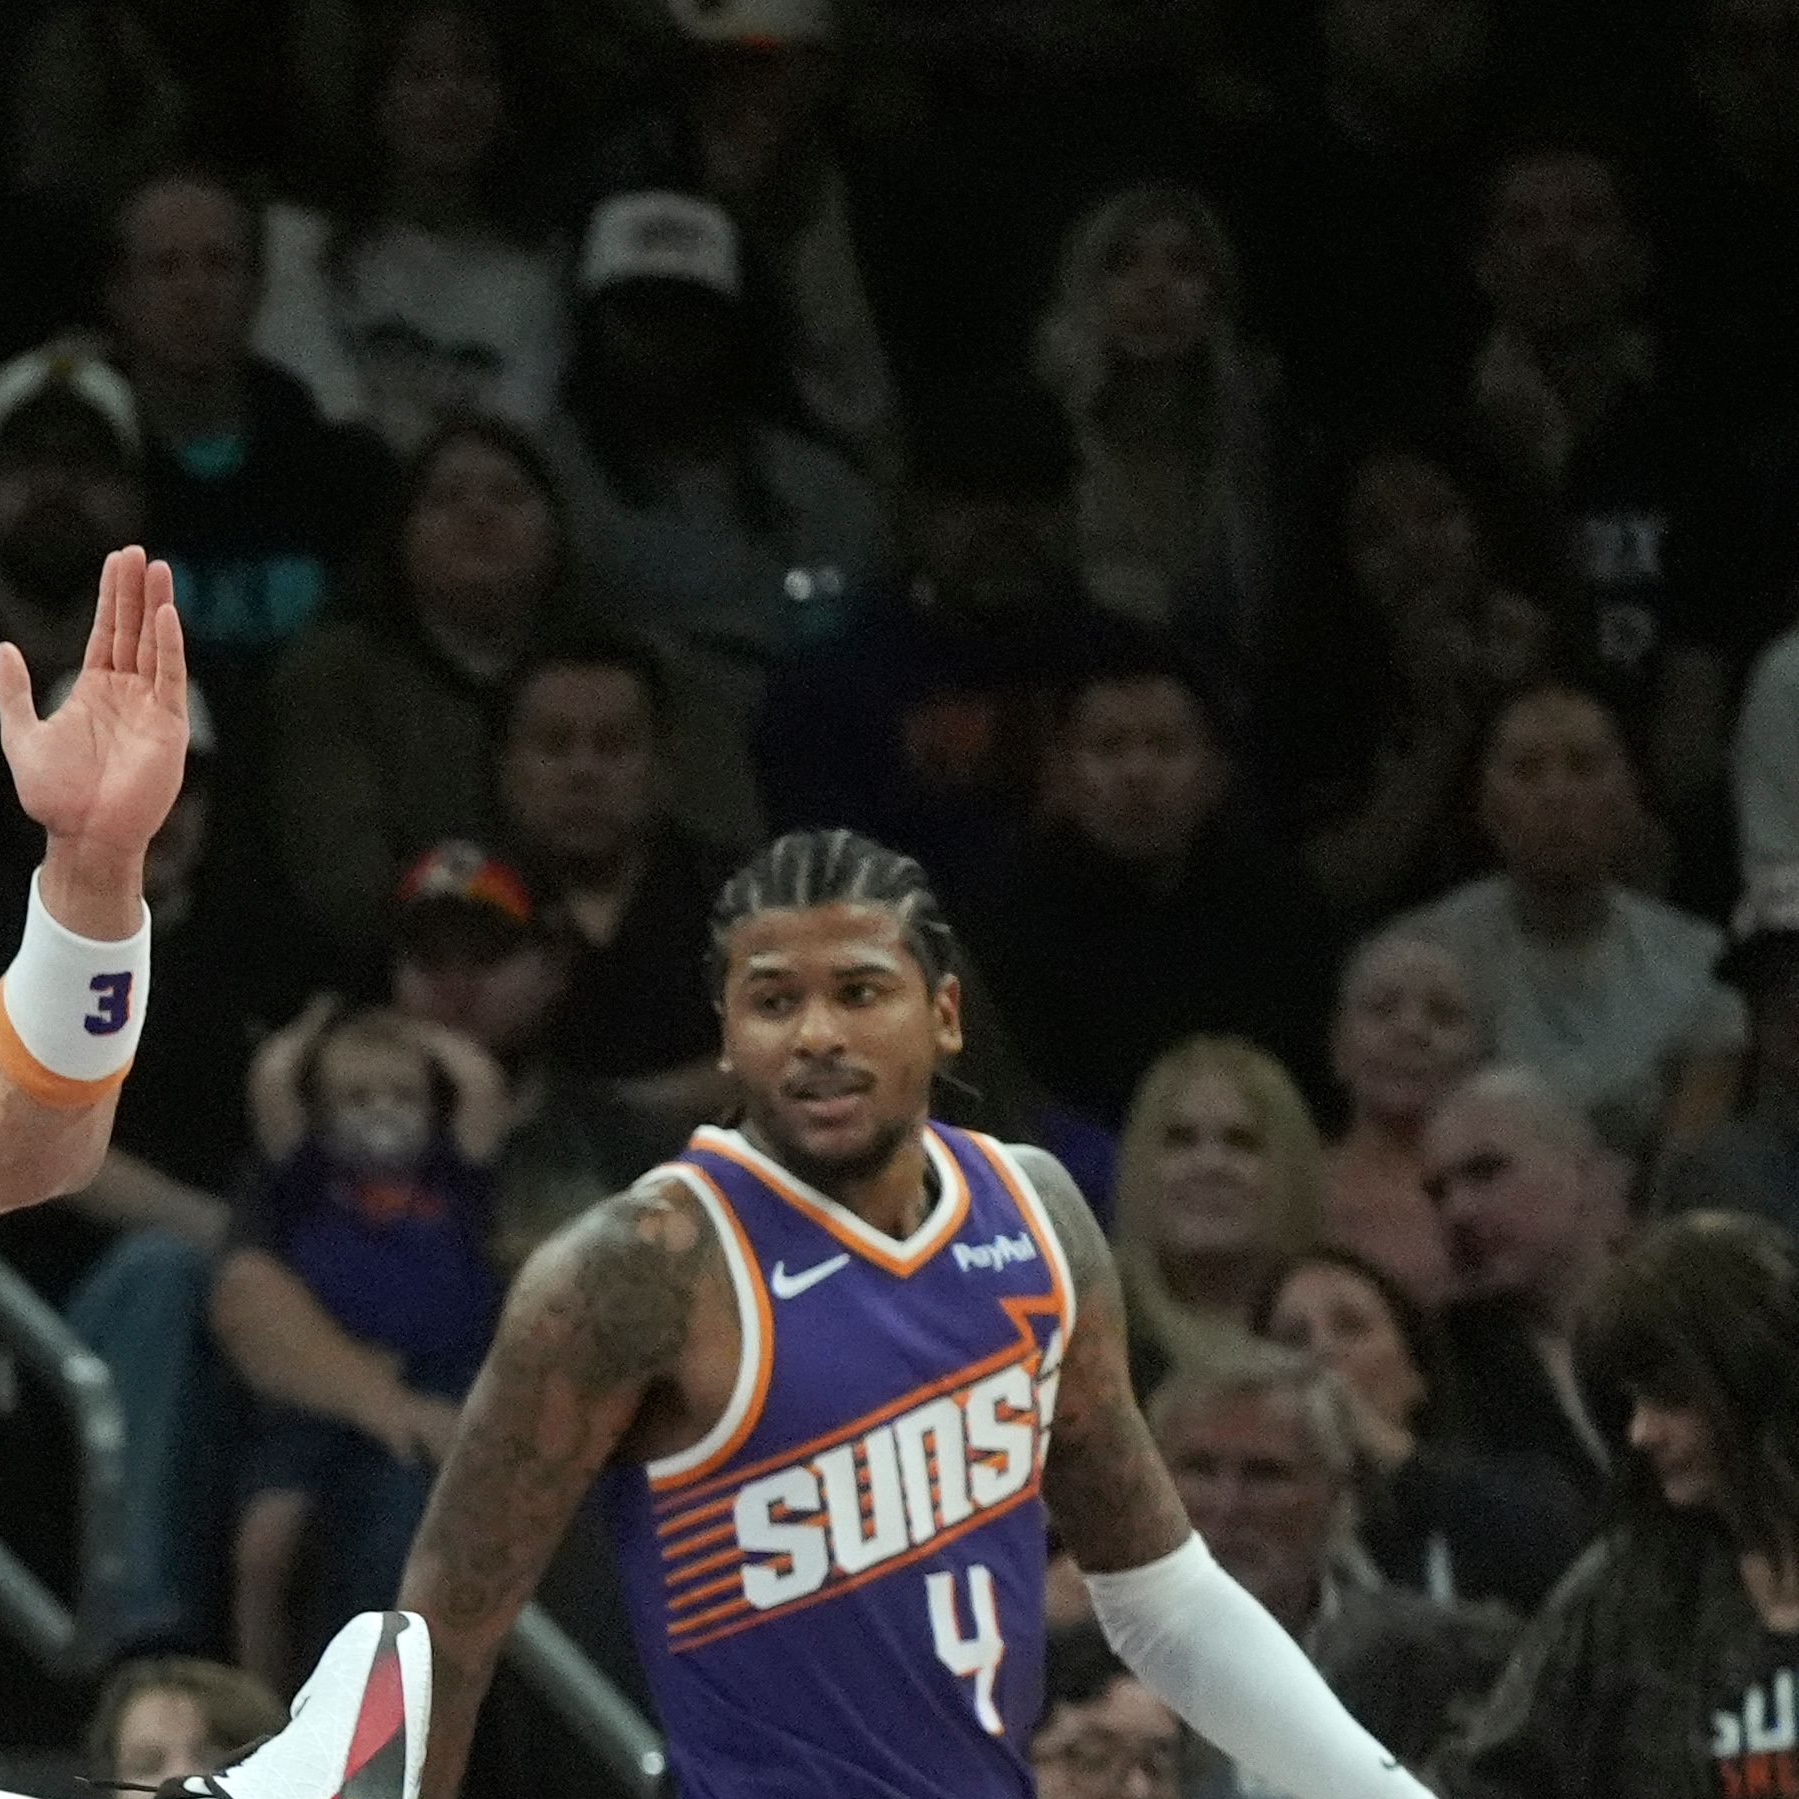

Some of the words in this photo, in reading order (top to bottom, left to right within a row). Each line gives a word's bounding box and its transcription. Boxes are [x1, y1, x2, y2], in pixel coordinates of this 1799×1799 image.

[84, 971, 135, 1036] 3
[734, 1363, 1035, 1611] SUNS
[925, 1564, 1006, 1737] 4
